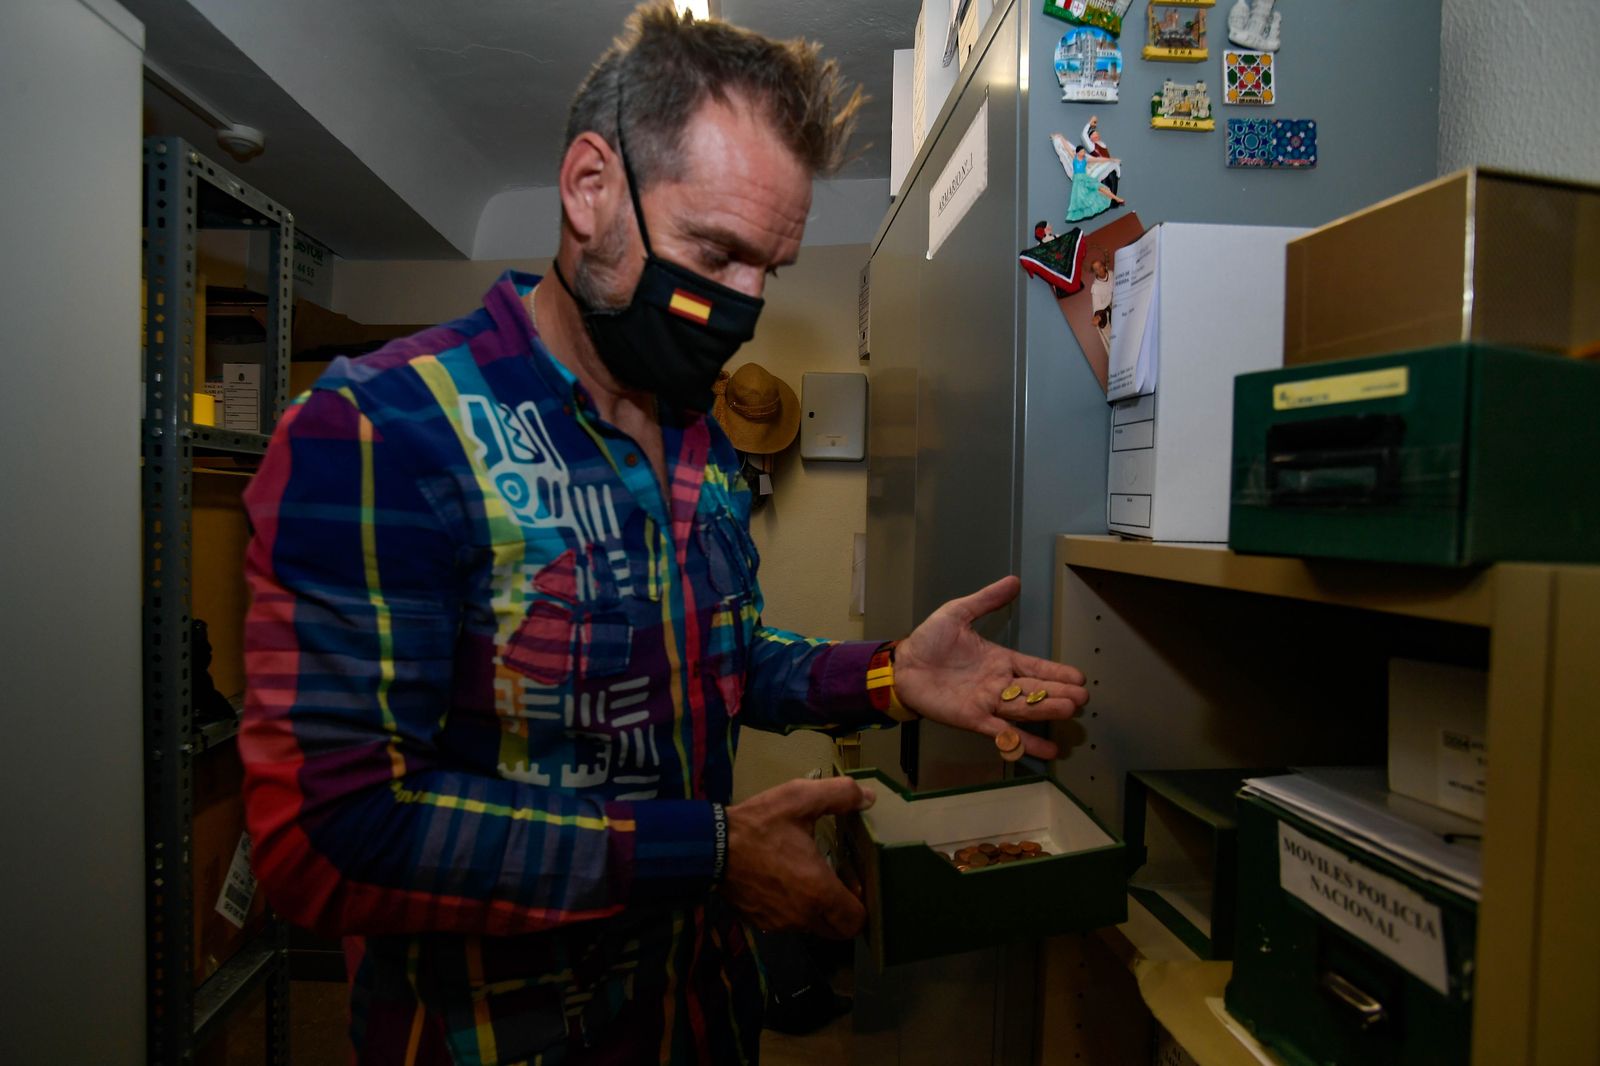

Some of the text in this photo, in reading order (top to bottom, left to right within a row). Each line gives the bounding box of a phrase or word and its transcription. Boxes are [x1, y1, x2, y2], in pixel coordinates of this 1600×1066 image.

[1167, 48, 1193, 56] ROMA
[1172, 120, 1198, 128] ROMA
[1283, 837, 1437, 939] MOVILES POLICIA
[1310, 873, 1400, 943] NACIONAL
